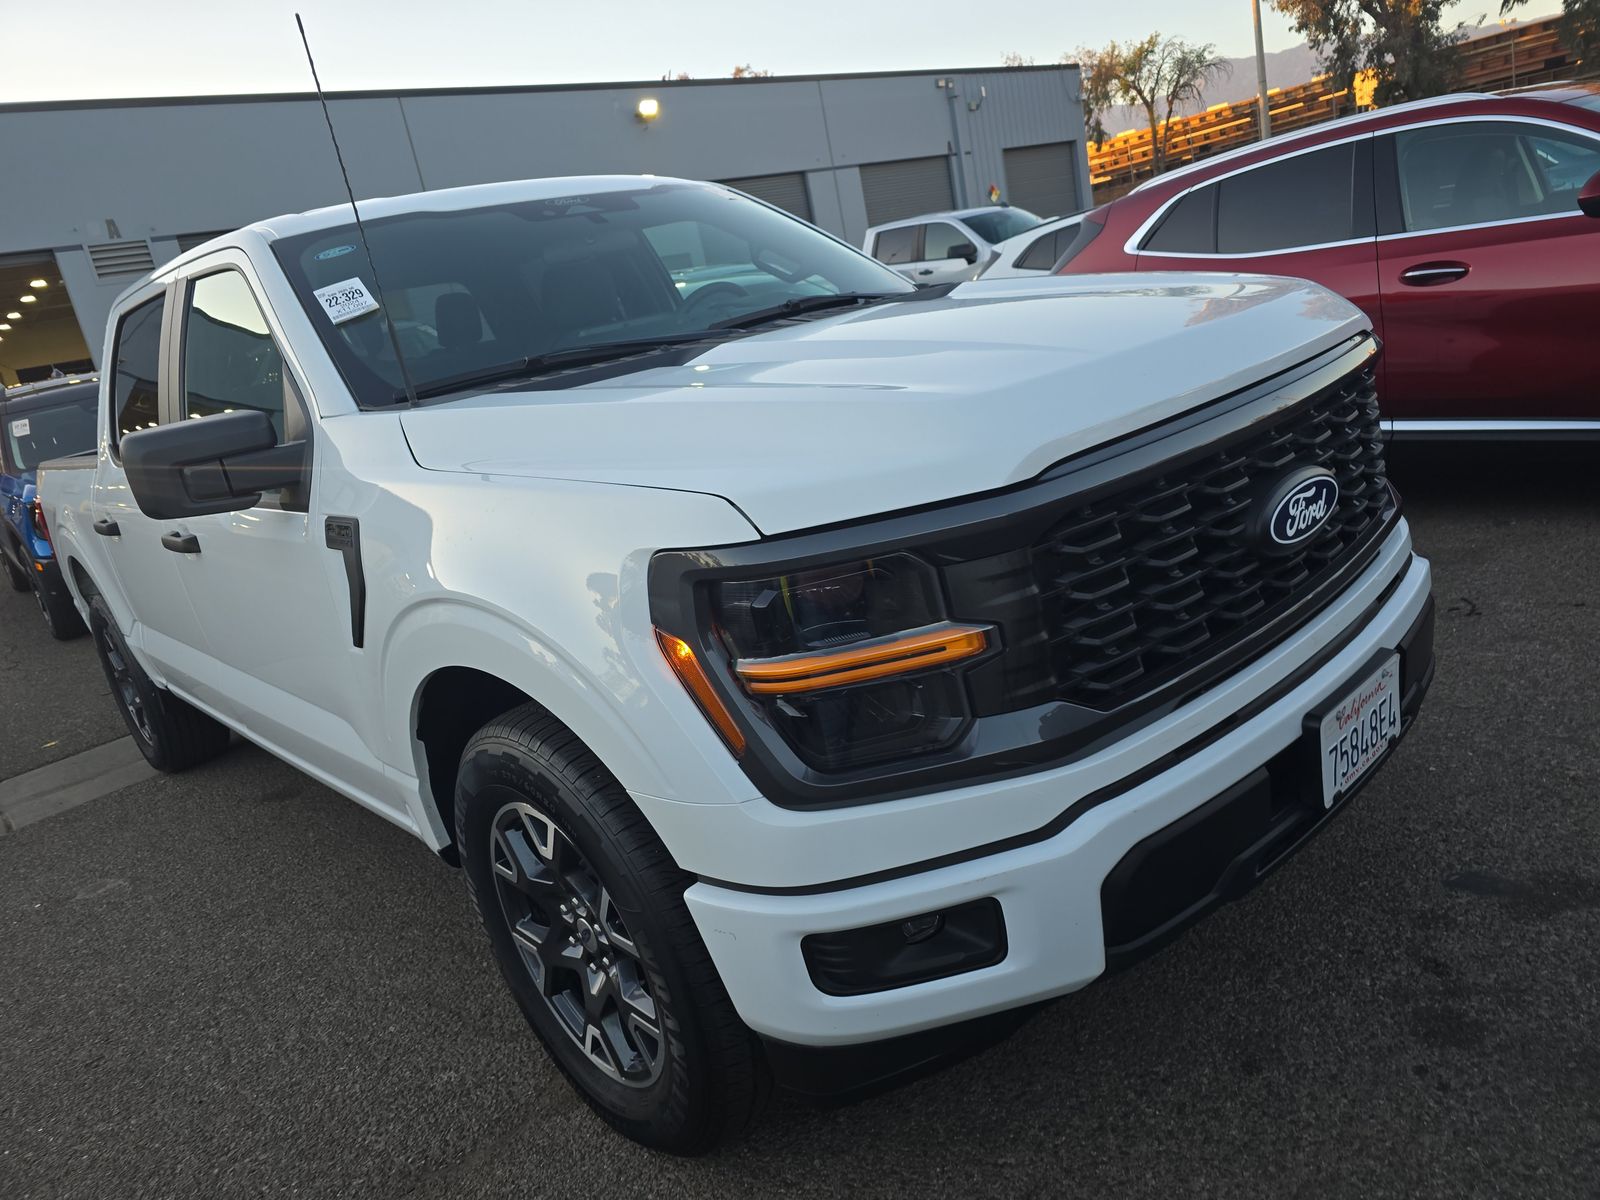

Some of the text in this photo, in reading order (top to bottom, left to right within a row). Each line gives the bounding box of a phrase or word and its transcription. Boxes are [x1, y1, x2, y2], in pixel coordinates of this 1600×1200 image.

[325, 288, 364, 308] 22:329
[1286, 486, 1327, 537] Ford
[1338, 680, 1387, 730] California
[1328, 692, 1396, 787] 75848E4
